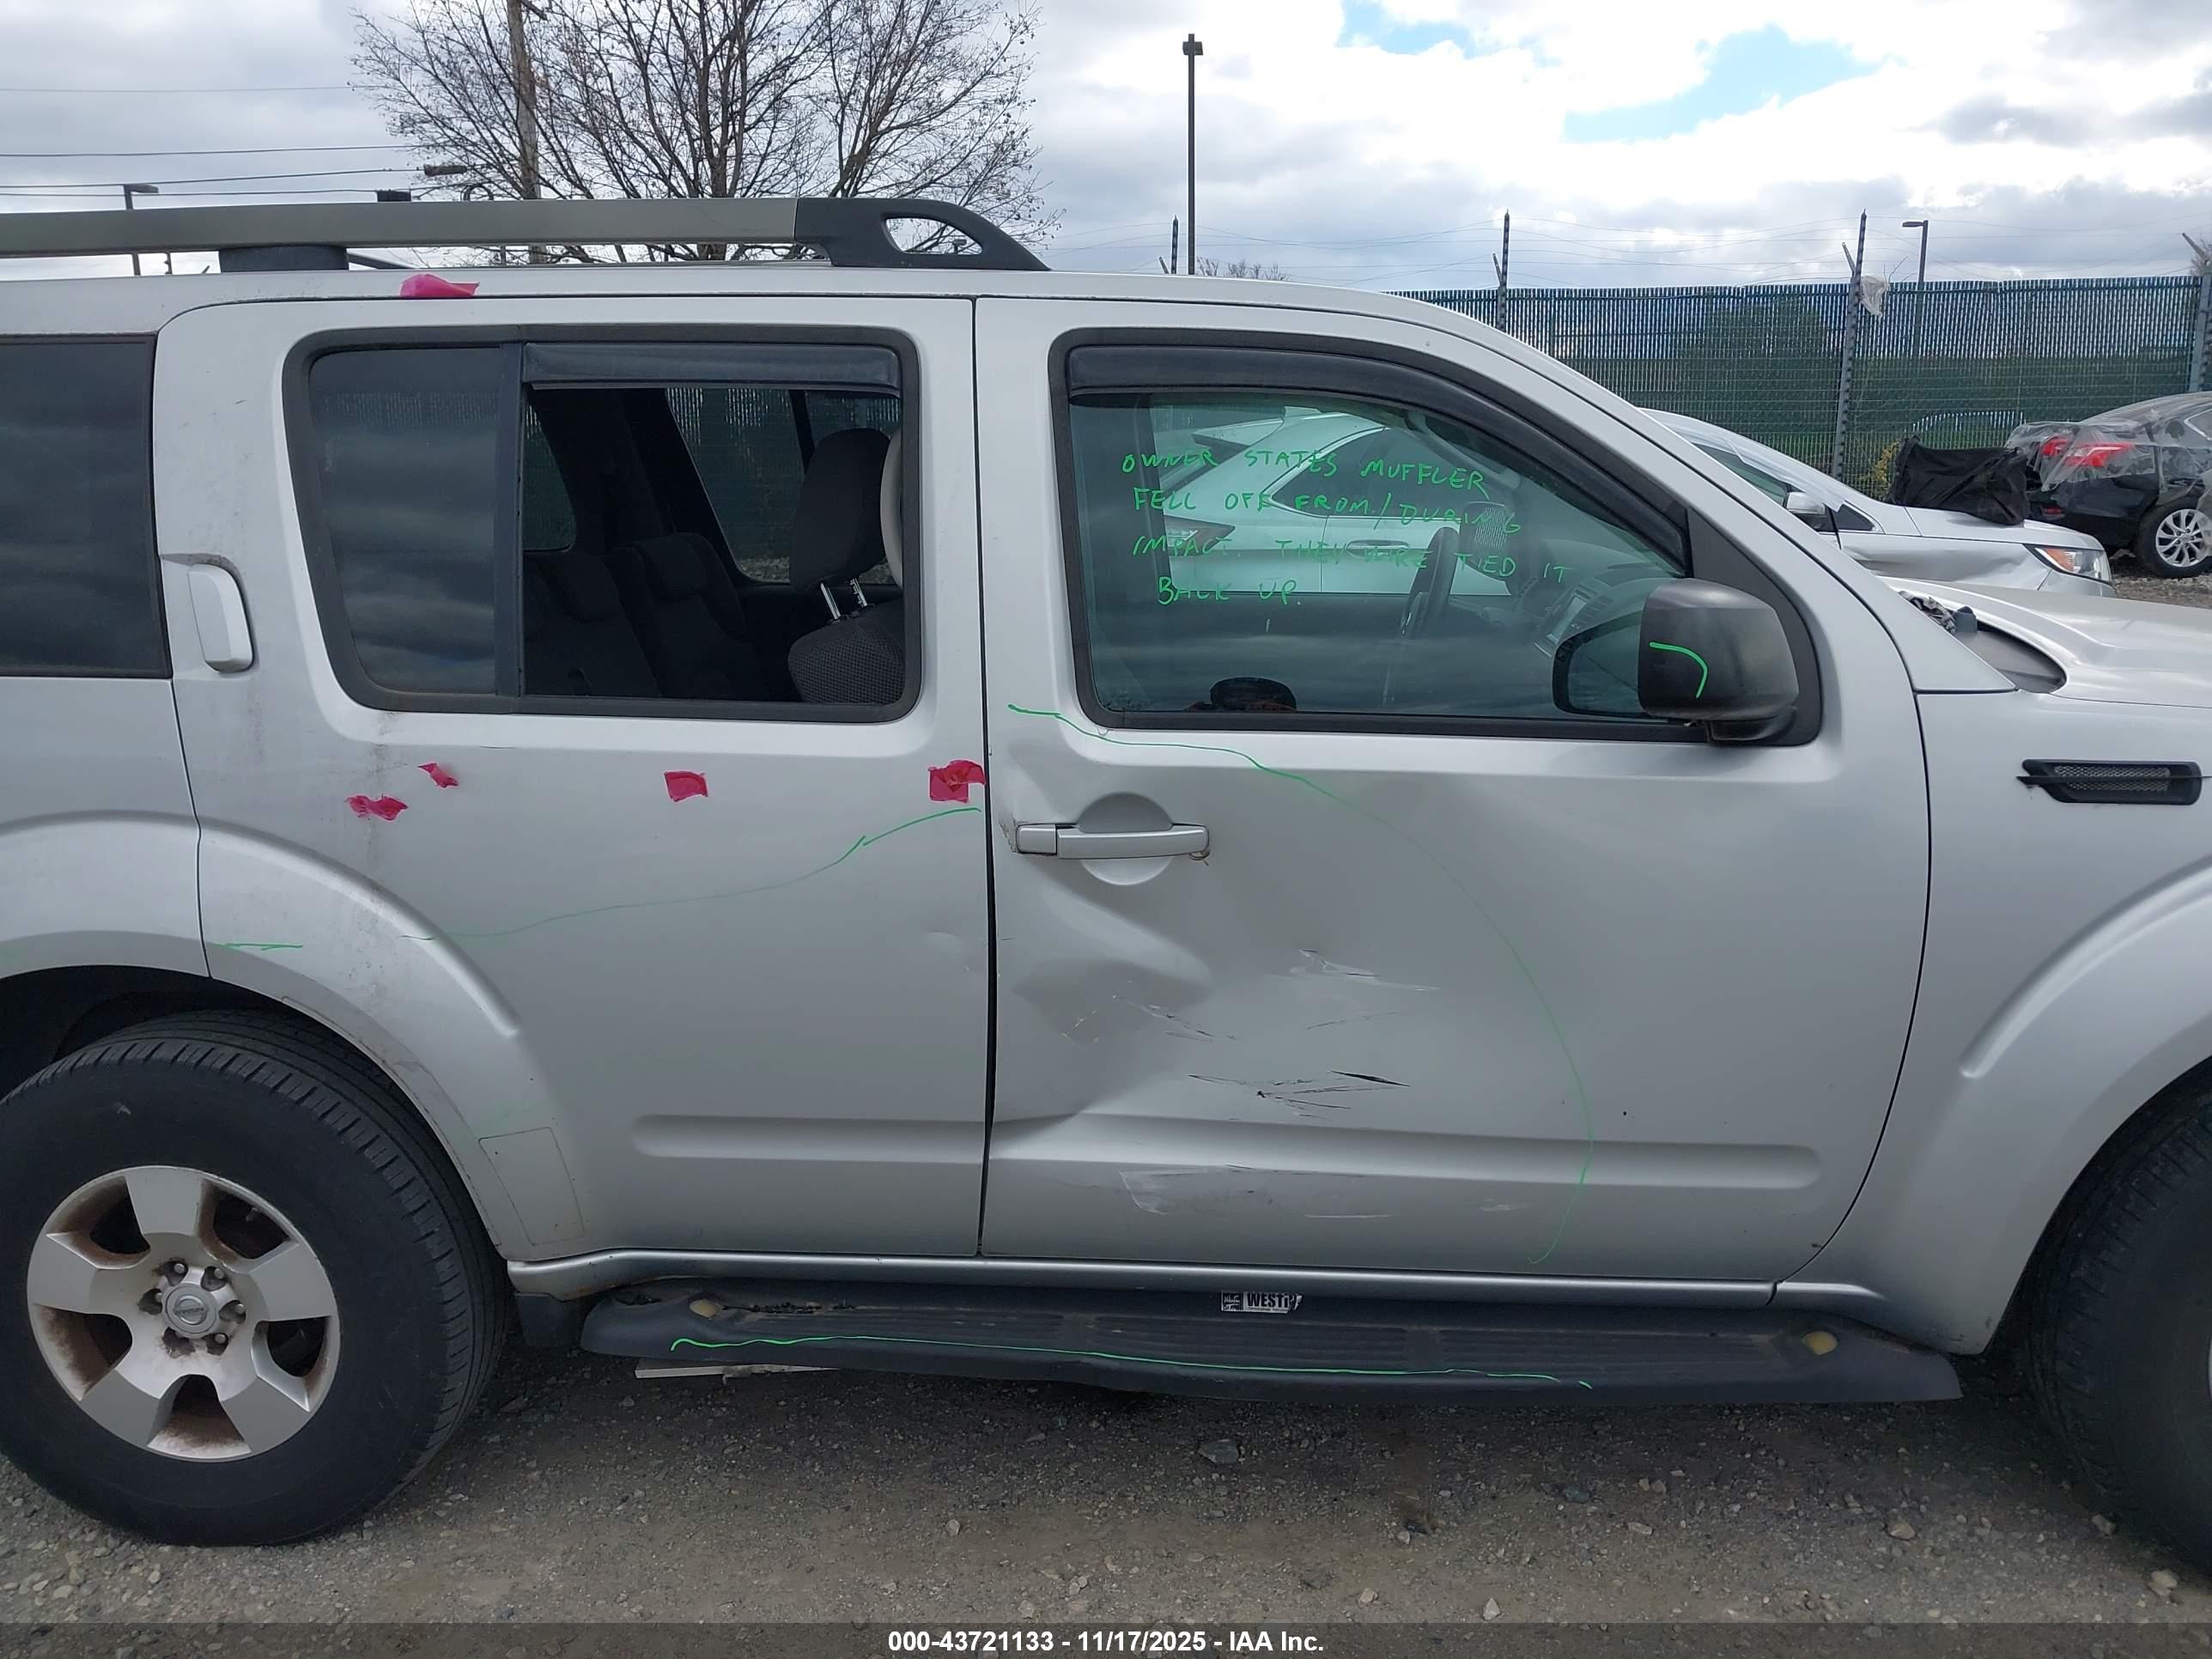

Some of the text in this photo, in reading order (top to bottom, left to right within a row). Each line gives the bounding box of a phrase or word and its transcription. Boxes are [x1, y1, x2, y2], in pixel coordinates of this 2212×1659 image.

[1121, 449, 1491, 501] OWNER STATES MUFFLER
[1133, 486, 1197, 510] FELL
[1224, 492, 1273, 512] OFF
[1275, 539, 1349, 565] THEY
[1453, 553, 1517, 578] TIED
[1542, 562, 1572, 584] IT
[1157, 576, 1232, 605] BACK
